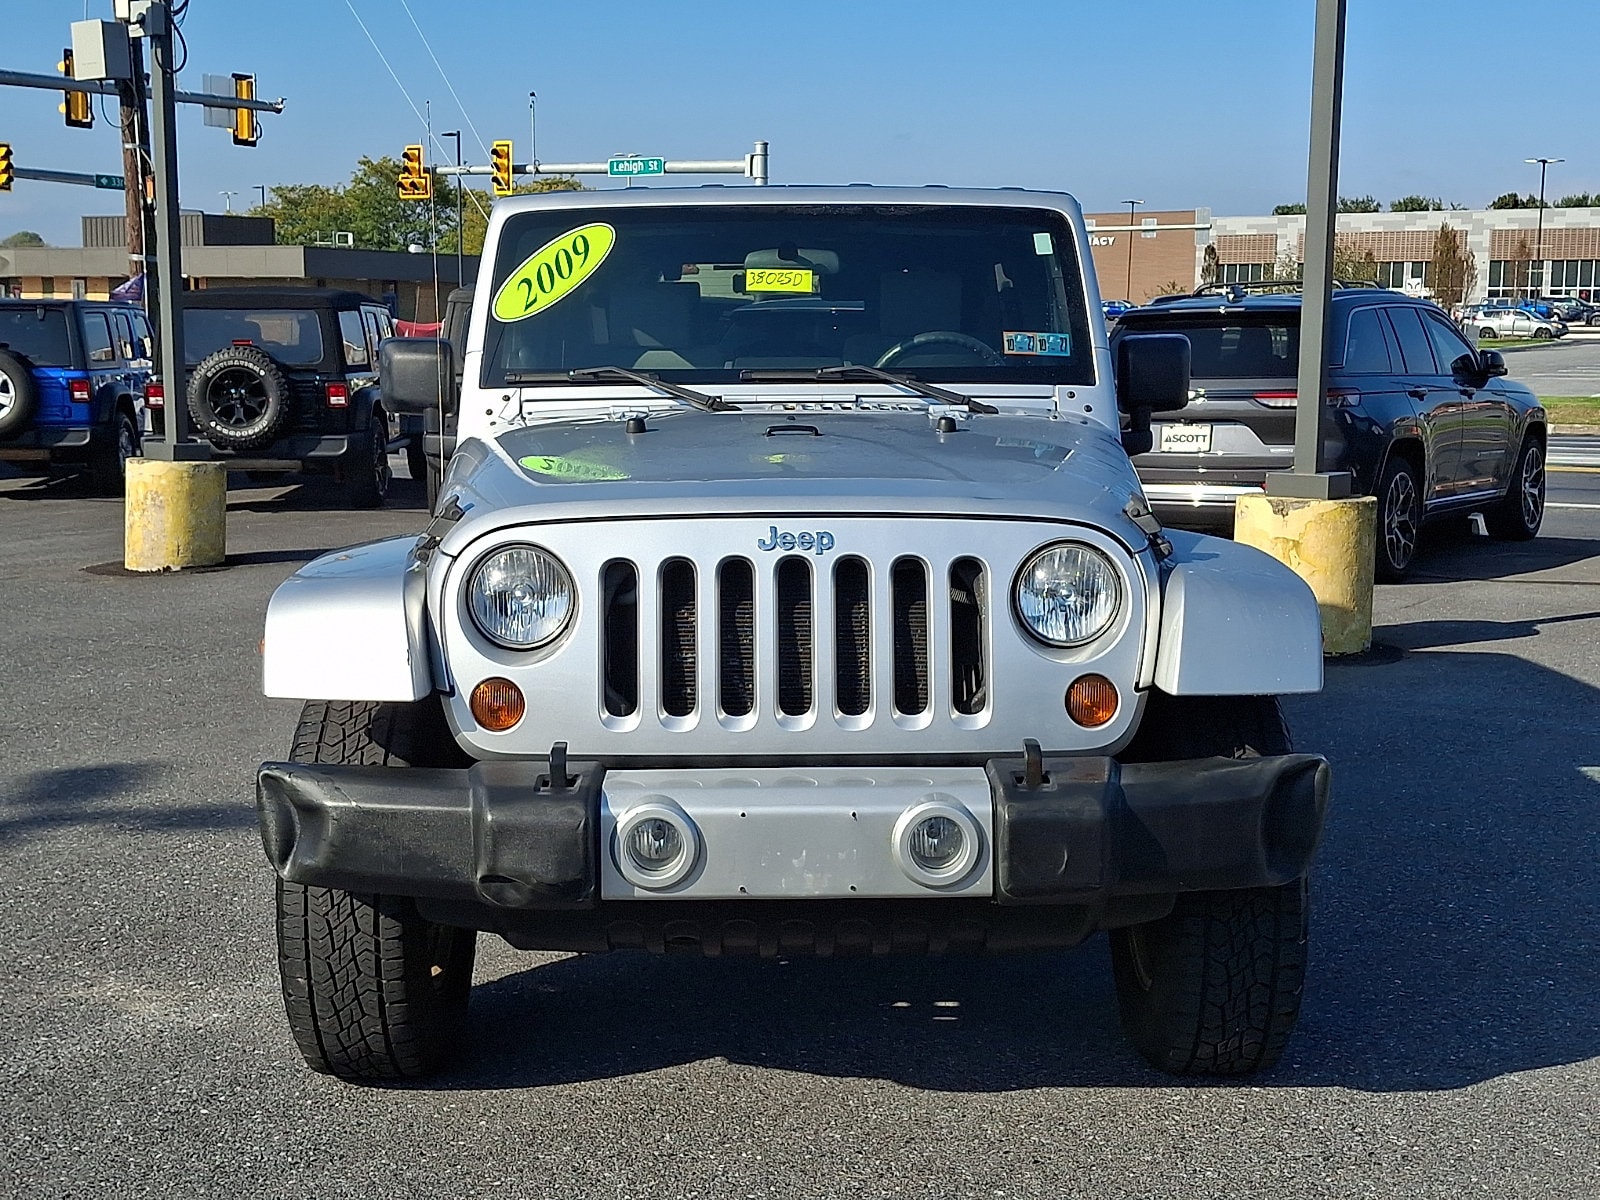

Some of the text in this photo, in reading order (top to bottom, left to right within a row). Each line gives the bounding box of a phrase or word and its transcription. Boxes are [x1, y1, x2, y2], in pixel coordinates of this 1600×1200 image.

[613, 160, 658, 174] Lehigh St
[517, 234, 590, 312] 2009
[1172, 434, 1208, 443] SCOTT
[757, 526, 835, 555] Jeep
